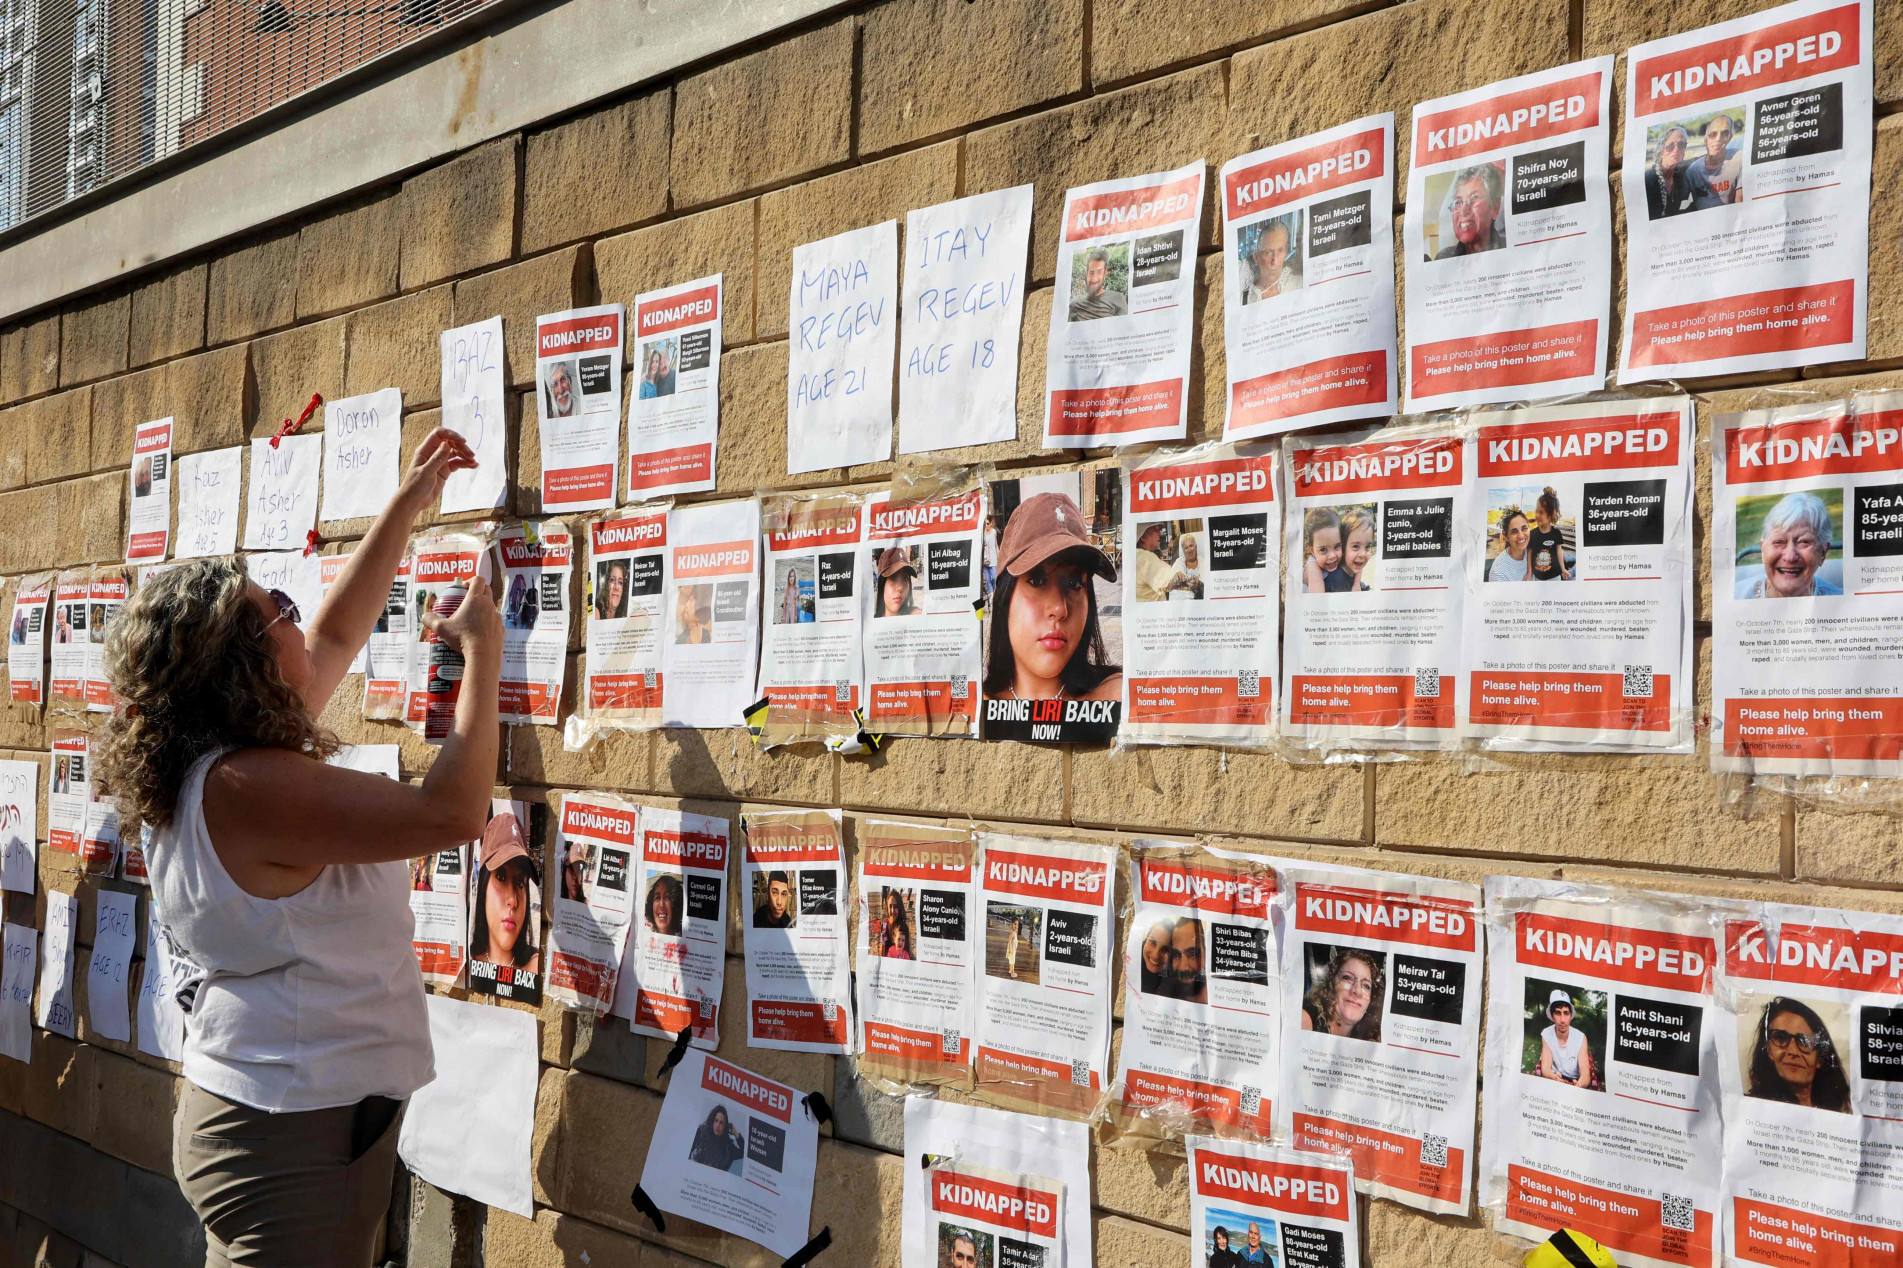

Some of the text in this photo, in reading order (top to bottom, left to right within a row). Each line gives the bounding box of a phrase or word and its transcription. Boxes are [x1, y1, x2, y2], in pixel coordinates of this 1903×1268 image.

[1650, 31, 1841, 99] KIDNAPPED
[1760, 93, 1820, 113] Avner Goren
[1427, 95, 1585, 152] KIDNAPPED
[1760, 104, 1819, 124] 56-years-old
[1759, 118, 1817, 136] Maya Goren
[1758, 128, 1818, 147] 56-years-old
[1757, 145, 1787, 159] Israeli
[1517, 158, 1568, 175] Shifra Noy
[1236, 149, 1370, 206] KIDNAPPED
[1516, 168, 1577, 188] 70-years-old
[1516, 188, 1546, 202] Israeli
[1075, 194, 1186, 230] KIDNAPPED
[1313, 203, 1366, 223] Tami Metzger
[1313, 215, 1361, 234] 78-years-old
[920, 223, 992, 268] ITAY
[1312, 232, 1336, 246] Israeli
[1136, 251, 1178, 266] 28-years-old
[1135, 266, 1156, 277] Israeli
[800, 260, 868, 307] MAYA
[918, 272, 1016, 323] REGEV
[643, 298, 712, 327] KIDNAPPED
[800, 297, 884, 352] REGEV
[542, 326, 611, 349] KIDNAPPED
[908, 340, 994, 378] AGE 18
[796, 367, 866, 409] AGE 21
[336, 408, 379, 437] Doron
[471, 396, 484, 450] 3
[137, 432, 167, 448] KIDNAPPED
[1489, 428, 1668, 462] KIDNAPPED
[1739, 428, 1903, 467] KIDNAPP
[336, 446, 372, 471] Asher
[1304, 450, 1453, 483] KIDNAPPED
[1138, 469, 1266, 500] KIDNAPPED
[258, 484, 300, 514] Asher
[1588, 495, 1660, 505] Yarden Roman
[1861, 497, 1891, 508] Yafa
[874, 502, 976, 530] KIDNAPPED
[1387, 505, 1444, 516] Emma & Julie
[1588, 506, 1648, 520] 36-years-old
[278, 520, 288, 541] 3
[1212, 527, 1264, 537] Margalit Moses
[1387, 518, 1412, 528] cunio,
[1588, 521, 1616, 531] Israeli
[210, 532, 218, 553] 5
[597, 522, 662, 545] KIDNAPPED
[1213, 537, 1254, 548] 78-years-old
[1386, 529, 1433, 541] 3-years-old
[1861, 527, 1902, 540] Israeli
[1213, 549, 1233, 557] Israeli
[1386, 541, 1441, 551] Israeli babies
[417, 559, 473, 575] KIDNAPPED
[677, 549, 749, 569] KIDNAPPED
[1506, 661, 1525, 670] photo
[1571, 662, 1586, 670] and
[1482, 680, 1602, 694] Please help bring them
[1482, 694, 1539, 705] home alive.
[987, 700, 1114, 723] BRING LIRI BACK
[1031, 724, 1061, 740] NOW!
[567, 810, 630, 834] KIDNAPPED
[648, 837, 722, 860] KIDNAPPED
[752, 835, 834, 852] KIDNAPPED
[869, 848, 966, 872] KIDNAPPED
[989, 861, 1101, 892] KIDNAPPED
[922, 894, 943, 903] Sharon
[922, 915, 958, 924] 34-years-old
[1049, 918, 1067, 928] Aviv
[1306, 896, 1465, 935] KIDNAPPED
[1049, 931, 1093, 947] 2-years-old
[1215, 927, 1251, 938] Shiri Bibas
[1048, 944, 1071, 955] Israeli
[1215, 937, 1256, 948] 33-years-old
[1525, 927, 1705, 977] KIDNAPPED
[1215, 947, 1258, 959] Yarden Bibas
[92, 954, 110, 974] AGE
[114, 963, 121, 982] 12
[1215, 957, 1256, 969] 34-years-old
[1398, 963, 1445, 979] Meirav Tal
[143, 969, 167, 997] AGE
[471, 961, 535, 989] BRING LIRI BACK
[496, 985, 512, 997] NOW!
[1397, 978, 1455, 995] 53-years-old
[1396, 991, 1423, 1003] Israeli
[1620, 1006, 1683, 1025] Amit Shani
[1620, 1021, 1690, 1042] 16-years-old
[1867, 1023, 1903, 1035] Silvia
[1619, 1035, 1652, 1051] Israeli
[708, 1065, 787, 1110] KIDNAPPED
[1203, 1163, 1339, 1204] KIDNAPPED
[939, 1182, 1049, 1223] KIDNAPPED
[1284, 1227, 1325, 1240] Gadi Moses
[1748, 1226, 1816, 1253] home alive.
[1749, 1210, 1894, 1252] Please help bring them
[1287, 1248, 1319, 1261] Efrat Katz
